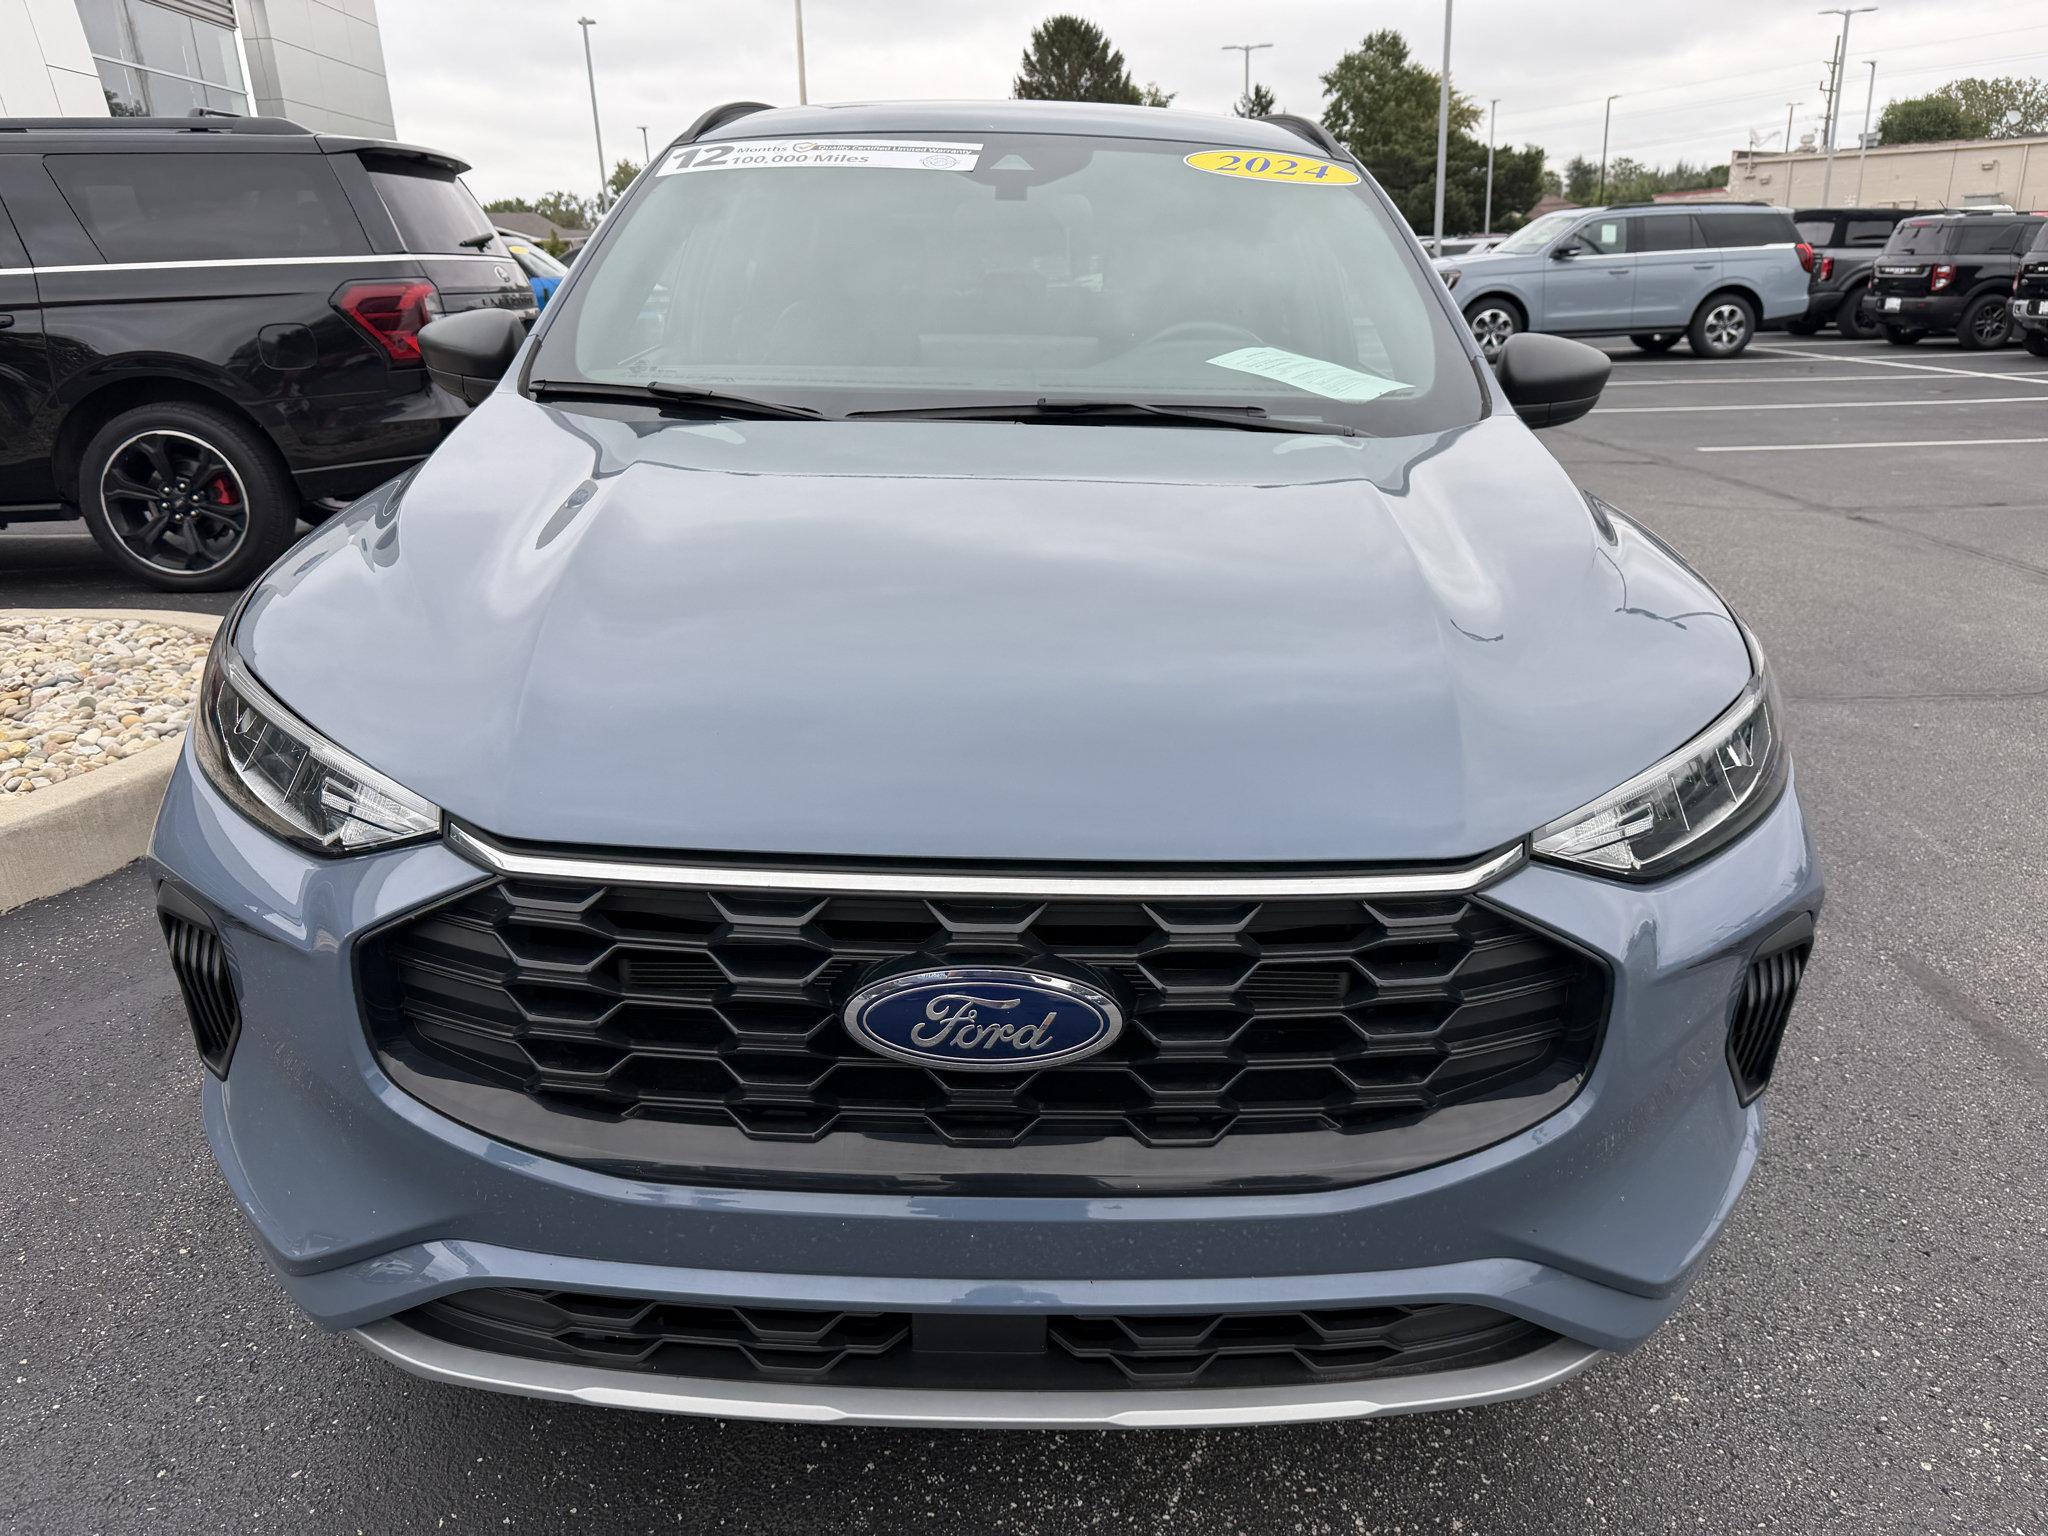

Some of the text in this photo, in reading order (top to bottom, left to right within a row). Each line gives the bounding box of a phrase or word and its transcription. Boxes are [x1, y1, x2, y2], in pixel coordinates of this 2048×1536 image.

[673, 145, 735, 169] 12
[732, 154, 870, 165] 100,000 Miles
[1215, 155, 1329, 178] 2024
[911, 994, 1057, 1050] Ford
